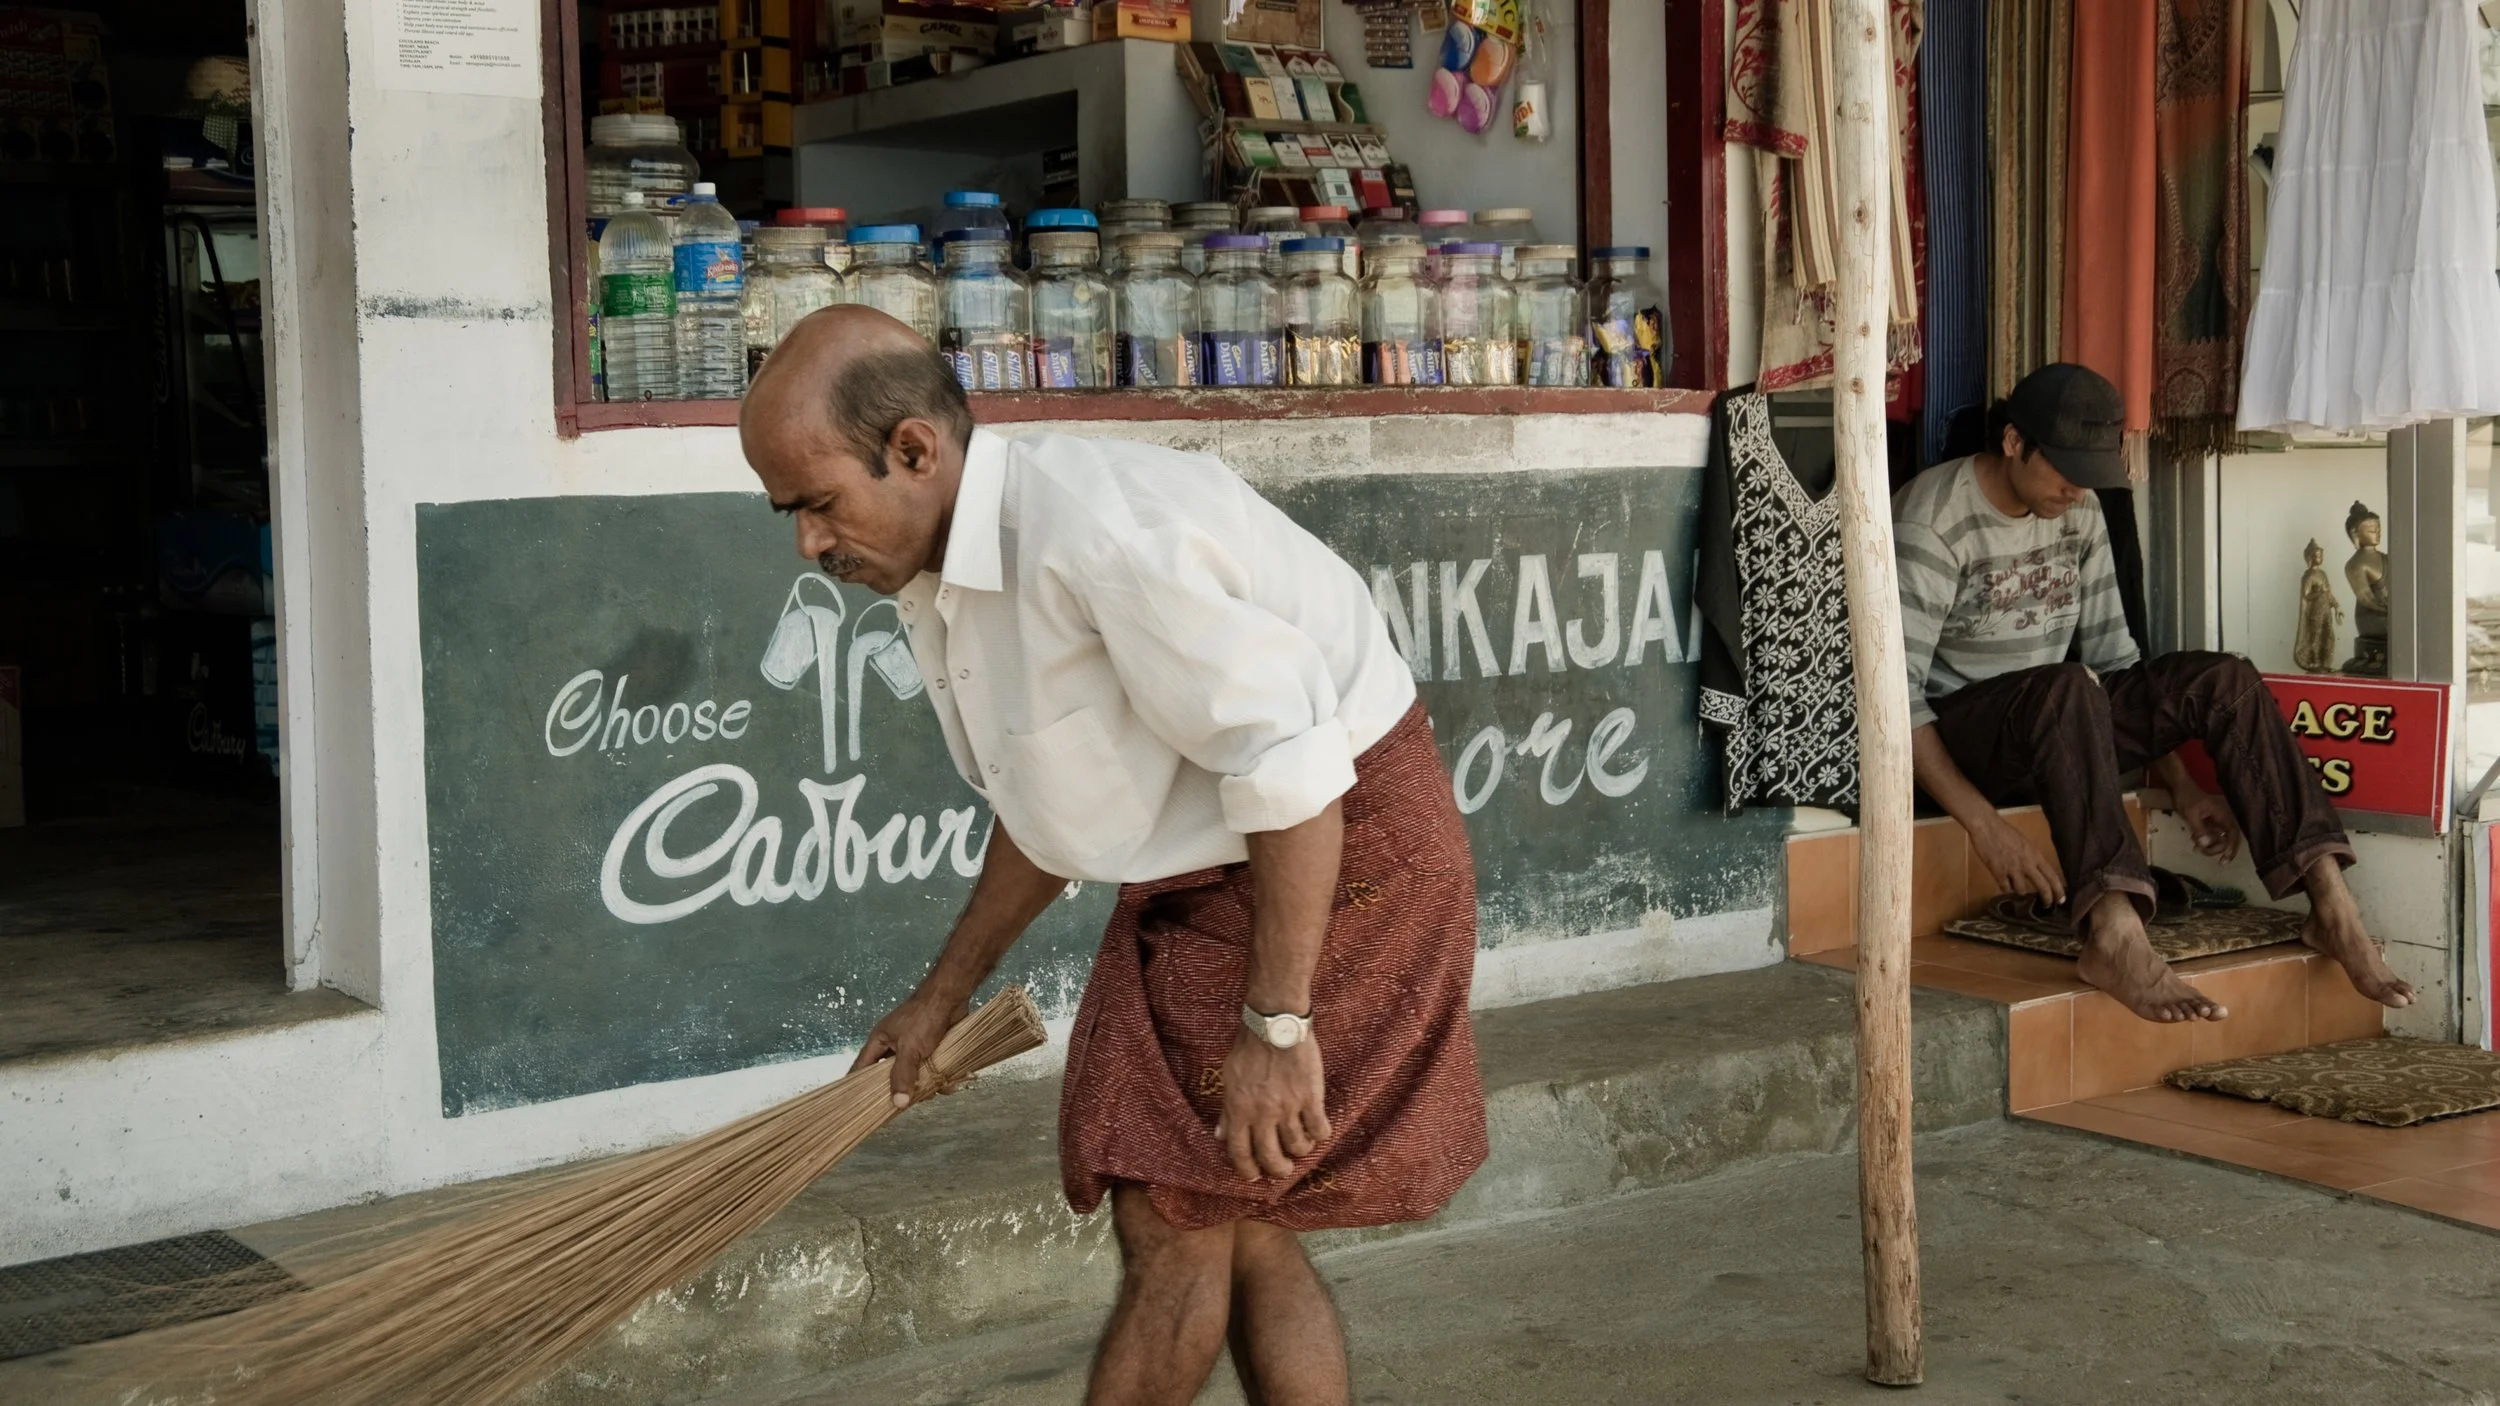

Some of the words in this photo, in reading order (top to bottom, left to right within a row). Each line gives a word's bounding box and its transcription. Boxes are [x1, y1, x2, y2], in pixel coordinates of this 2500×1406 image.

[919, 22, 962, 37] CAMEL
[1138, 18, 1170, 26] IMPERIAL
[1185, 340, 1196, 376] DAIRY
[1220, 342, 1233, 377] DAIRY
[1260, 341, 1273, 377] DAIRY
[1426, 349, 1436, 376] DAIRY
[1370, 550, 1700, 681] NKAJA
[545, 669, 752, 757] Choose
[2290, 700, 2395, 741] AGE
[1430, 706, 1650, 815] ore
[601, 764, 998, 924] Cadbur
